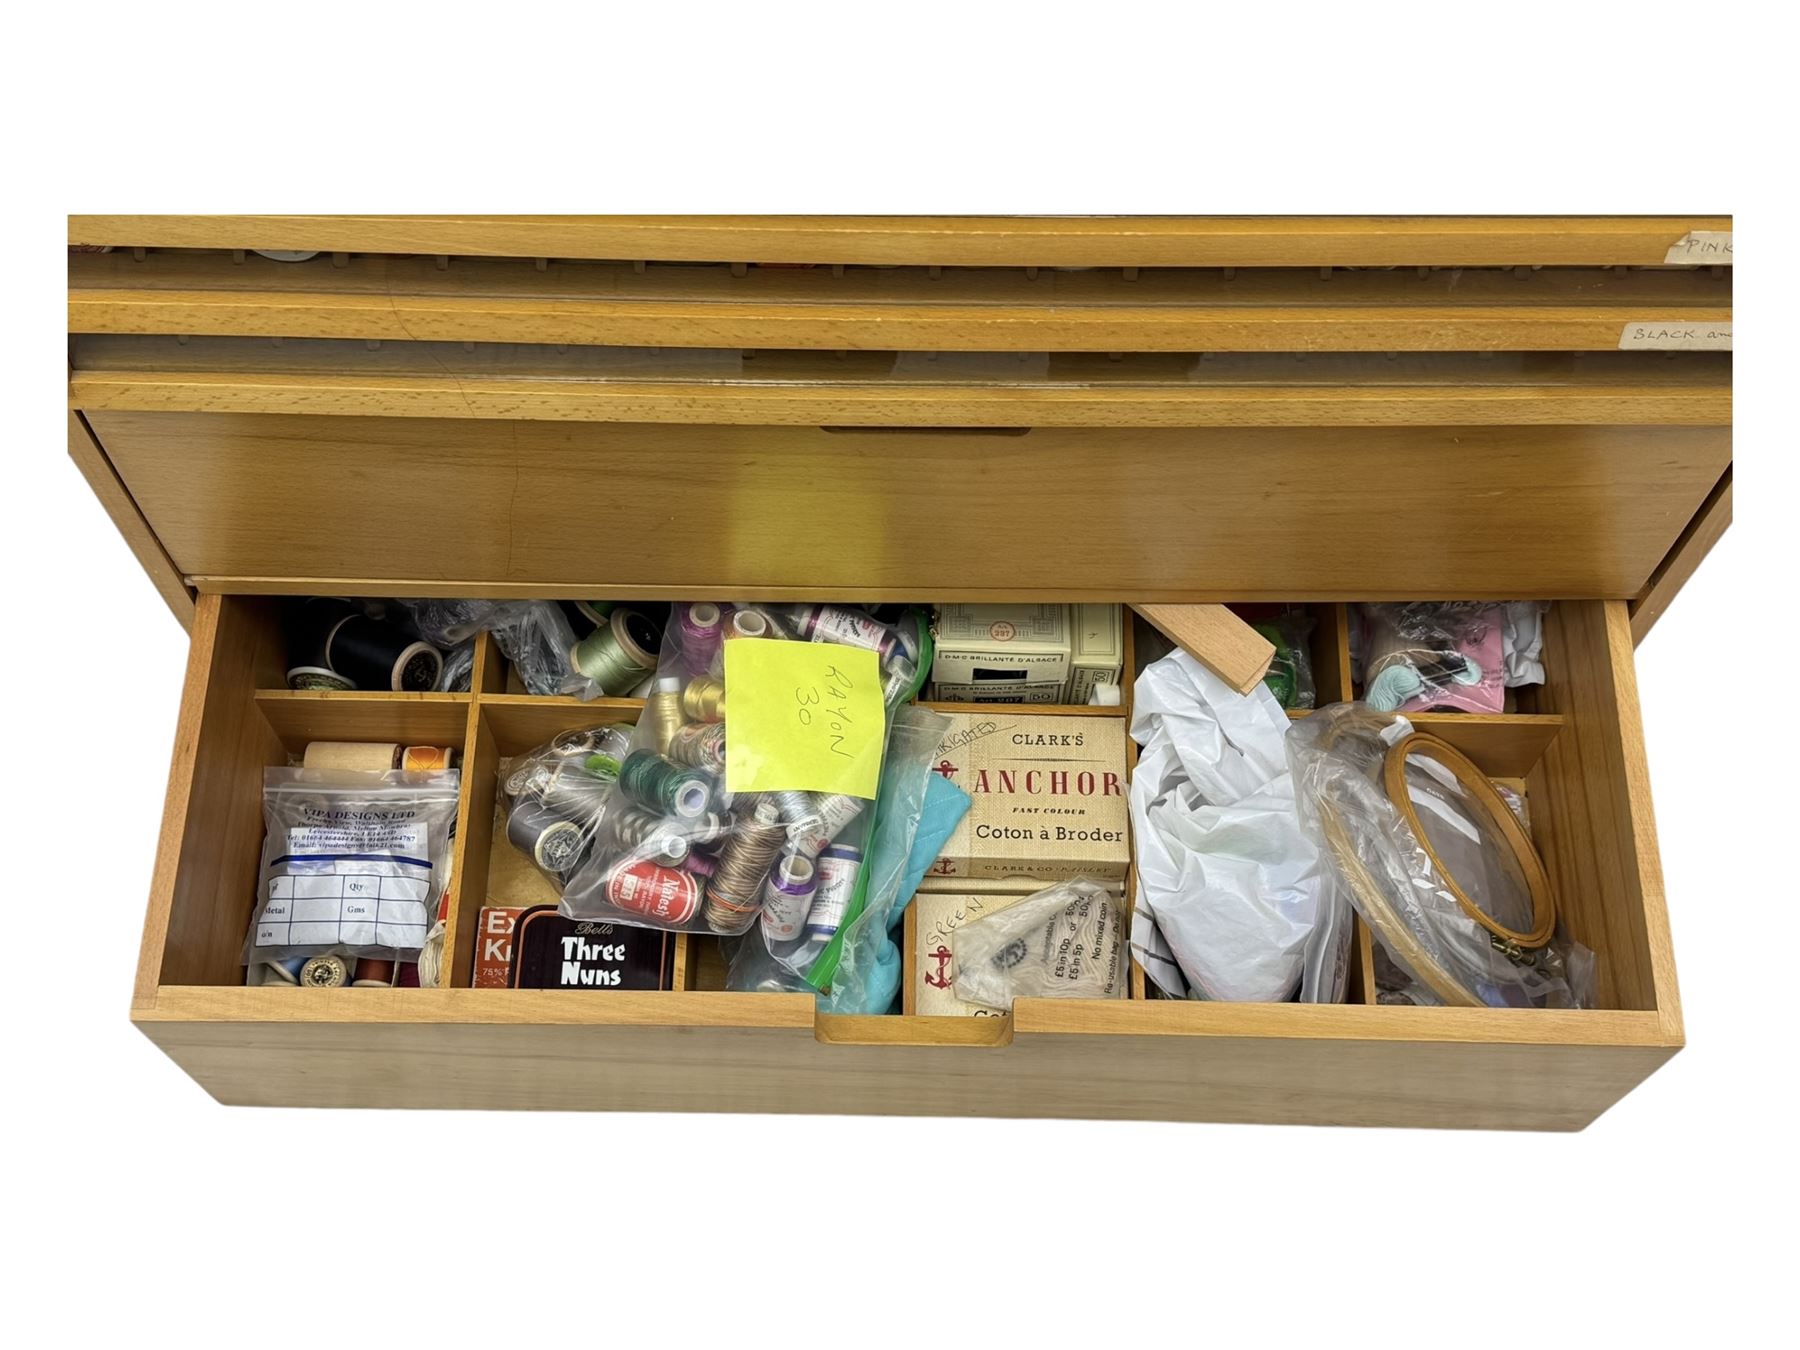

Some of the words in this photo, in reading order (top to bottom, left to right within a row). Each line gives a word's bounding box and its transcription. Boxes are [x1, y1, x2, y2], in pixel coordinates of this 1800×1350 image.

[1633, 328, 1696, 341] BLACK
[1707, 330, 1733, 339] an
[796, 687, 820, 726] 30
[825, 665, 855, 759] RAYON
[1012, 733, 1084, 746] CLARK'S
[974, 769, 1122, 797] ANCHOR
[304, 808, 331, 819] VIPA
[335, 810, 389, 821] DESIGNS
[391, 811, 416, 820] LTD
[976, 824, 1034, 840] Coton
[1040, 825, 1050, 840] à
[1055, 826, 1124, 842] Broder
[349, 883, 364, 892] Qty
[652, 874, 681, 917] Natesh
[347, 905, 365, 914] Gms
[1099, 902, 1108, 920] coin
[575, 921, 614, 935] Bell's
[926, 897, 984, 946] GREEN
[1069, 921, 1077, 932] or
[1097, 920, 1106, 946] mixed
[561, 936, 626, 961] Three
[1059, 938, 1071, 955] 10p
[1073, 943, 1085, 957] 5p
[1091, 947, 1101, 960] No
[1060, 956, 1067, 965] in
[1104, 956, 1117, 994] Re-usable
[1111, 941, 1120, 956] bag
[561, 961, 622, 986] Nuns
[1054, 965, 1065, 978] £5
[1068, 967, 1079, 980] £5
